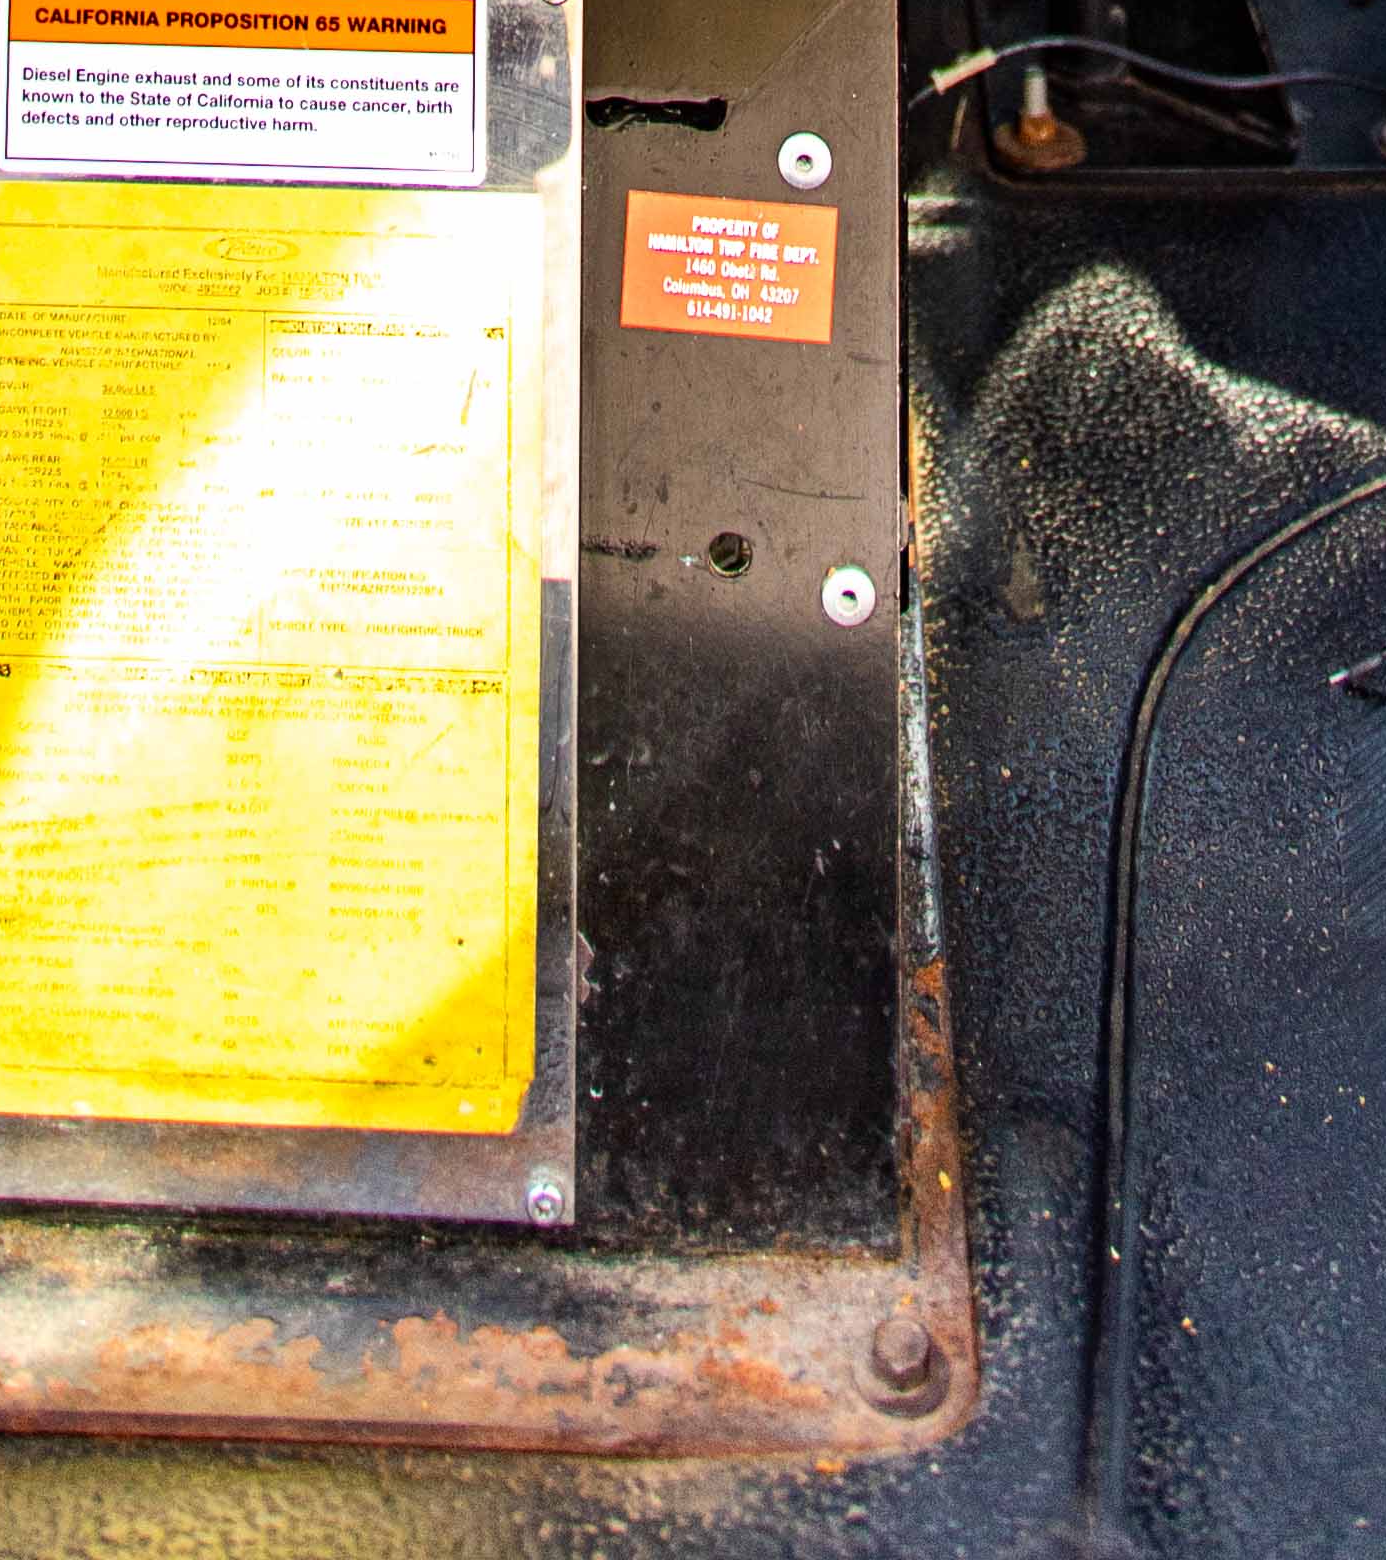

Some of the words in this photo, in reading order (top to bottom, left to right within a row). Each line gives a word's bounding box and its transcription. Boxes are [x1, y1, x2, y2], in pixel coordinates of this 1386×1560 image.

[34, 6, 160, 27] CALIFORNIA
[166, 11, 309, 32] PROPOSITION
[315, 16, 341, 33] 65
[347, 17, 447, 35] WARNING
[22, 66, 72, 82] Diesel
[76, 68, 130, 87] Engine
[135, 70, 198, 87] exhaust
[202, 73, 233, 87] and
[237, 76, 281, 88] some
[286, 75, 301, 89] of
[306, 75, 325, 90] its
[330, 76, 430, 93] constituents
[434, 81, 460, 93] are
[21, 88, 75, 104] known
[79, 90, 95, 105] to
[100, 90, 125, 106] the
[130, 91, 172, 107] State
[176, 93, 193, 108] of
[197, 94, 274, 110] California
[278, 96, 294, 111] to
[299, 99, 347, 112] cause
[352, 100, 412, 115] cancer,
[416, 100, 453, 115] birth
[21, 111, 80, 126] defects
[85, 113, 114, 127] and
[119, 114, 161, 128] other
[165, 116, 267, 132] reproductive
[272, 118, 318, 133] harm.
[692, 215, 759, 239] PROPERTY
[761, 221, 780, 240] OF
[782, 245, 820, 265] DEPT.
[760, 263, 781, 282] Rd.
[662, 275, 726, 300] Columbus,
[730, 282, 750, 301] OH
[759, 285, 800, 306] 43207
